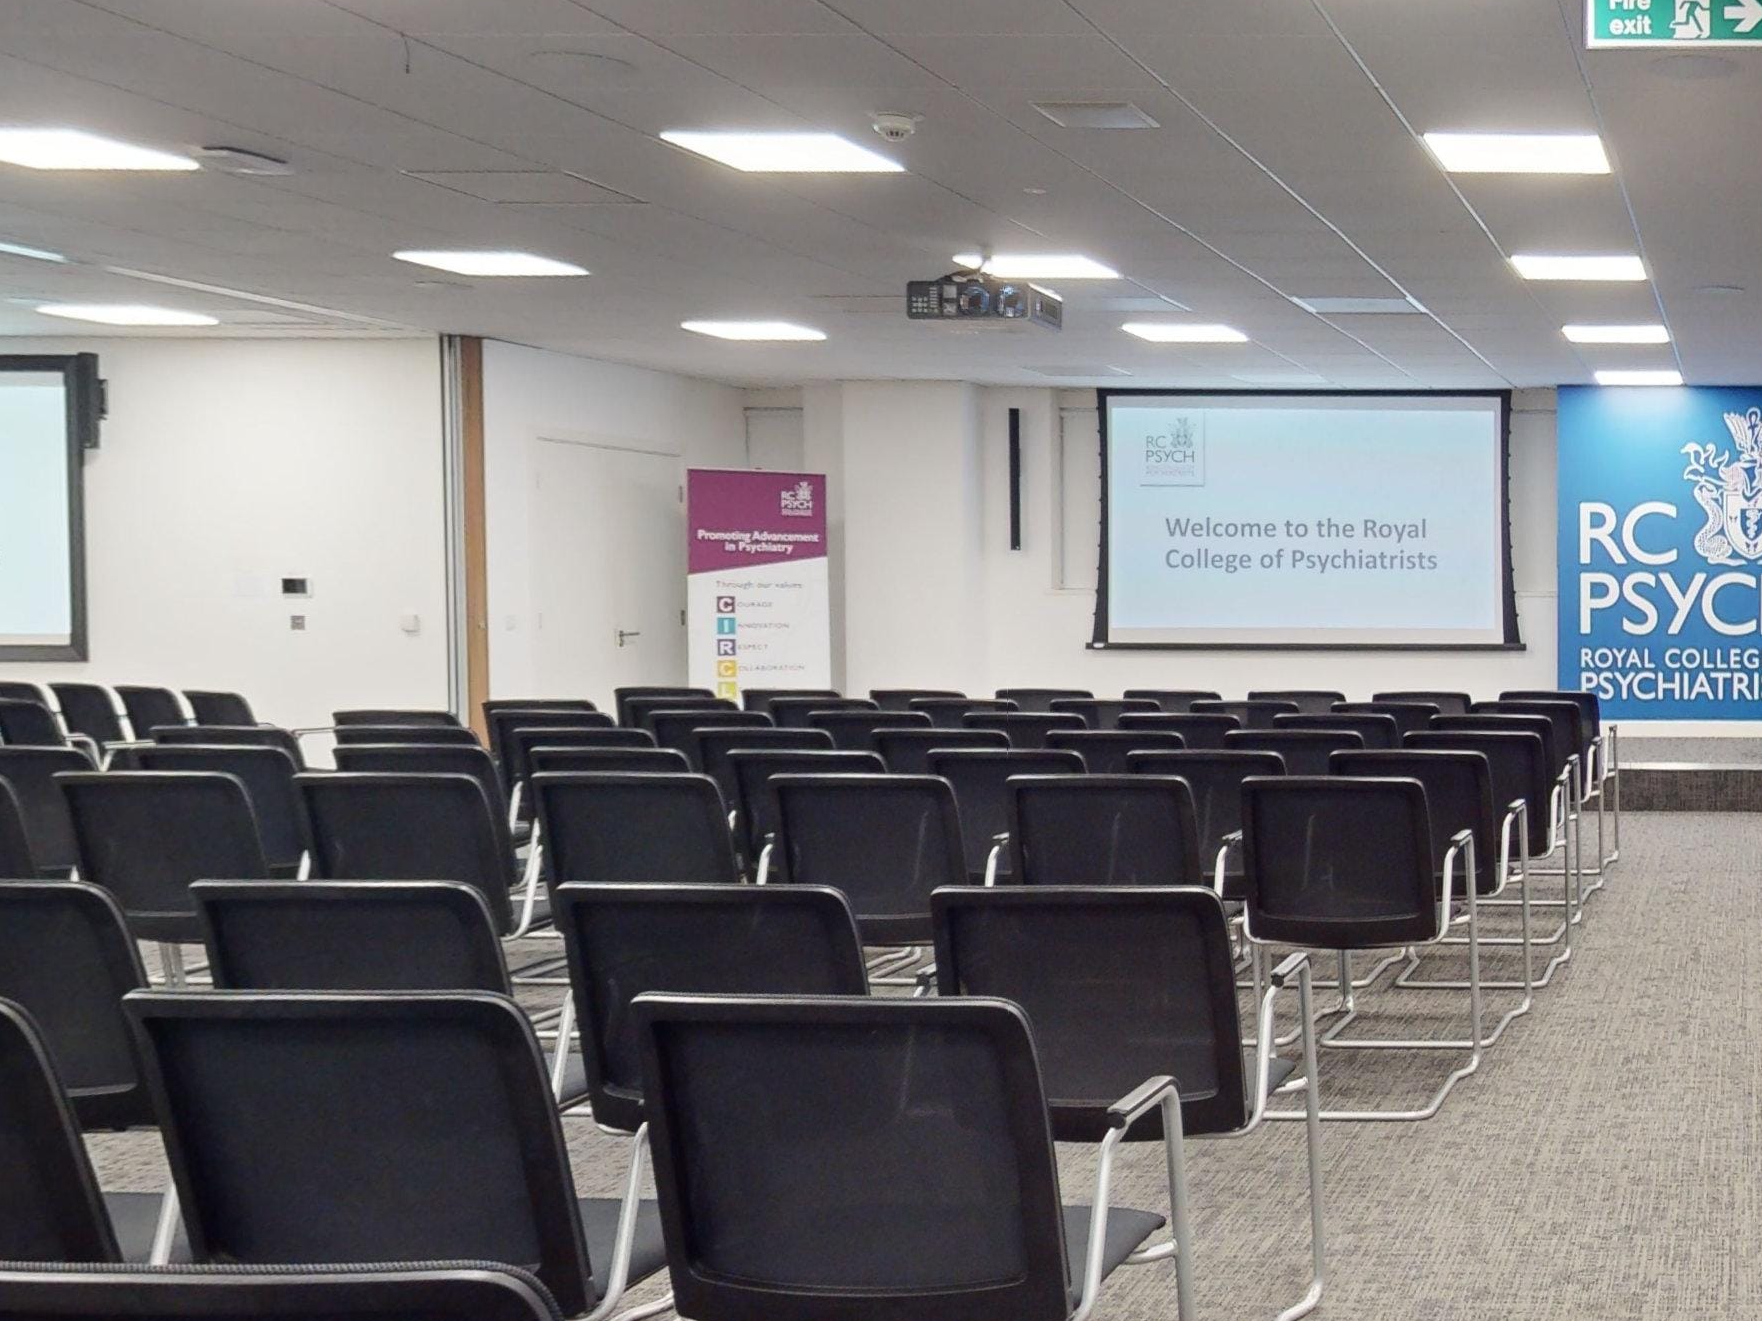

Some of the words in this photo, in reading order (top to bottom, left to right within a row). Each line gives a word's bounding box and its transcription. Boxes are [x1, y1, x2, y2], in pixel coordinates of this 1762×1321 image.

[1609, 15, 1652, 35] exit
[1145, 435, 1167, 449] RC
[1146, 450, 1195, 463] PSYCH
[781, 500, 813, 509] PSYCH
[697, 529, 751, 543] Promoting
[752, 530, 819, 543] Advancement
[1165, 517, 1277, 538] Welcome
[1284, 521, 1309, 538] to
[1316, 517, 1355, 538] the
[1363, 518, 1427, 544] Royal
[1579, 501, 1678, 565] RC
[725, 542, 736, 552] in
[738, 542, 794, 554] Psychiatry
[1165, 548, 1252, 574] College
[1260, 547, 1285, 570] of
[1291, 548, 1438, 574] Psychiatrists
[1580, 647, 1656, 669] ROYAL
